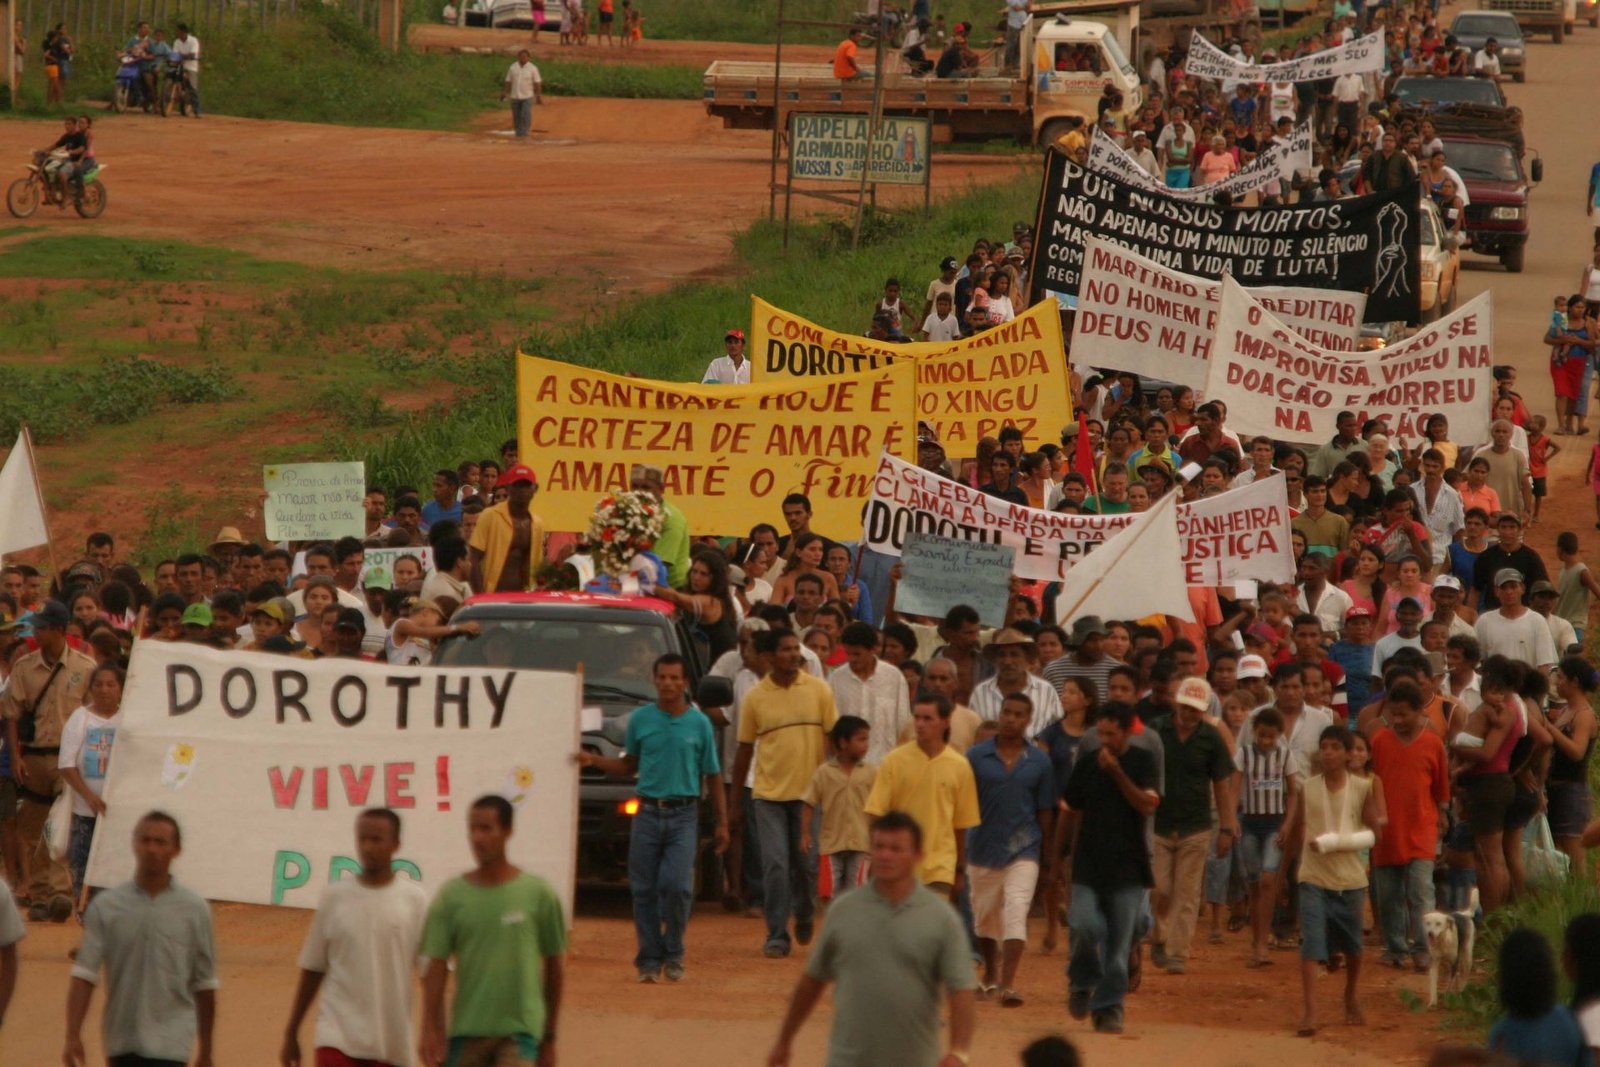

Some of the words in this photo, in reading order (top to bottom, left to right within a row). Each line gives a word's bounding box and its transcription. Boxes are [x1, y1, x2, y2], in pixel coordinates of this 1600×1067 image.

[795, 160, 831, 176] NOSSA
[1062, 160, 1116, 202] POR
[1129, 191, 1223, 230] NOSSOS
[1057, 193, 1096, 224] NÃO
[1100, 208, 1170, 246] APENAS
[1173, 228, 1202, 251] UM
[1205, 233, 1270, 257] MINUTO
[1274, 238, 1294, 257] DE
[1301, 231, 1368, 256] SILÊNCIO
[1046, 265, 1081, 286] REGI
[1092, 247, 1198, 298] MARTÍRIO
[1206, 287, 1220, 302] É
[1192, 253, 1234, 275] VIDA
[1242, 258, 1264, 276] DE
[1276, 254, 1340, 281] LUTA!
[1086, 278, 1120, 306] NO
[1127, 286, 1200, 327] HOMEM
[1247, 306, 1262, 326] O
[1448, 313, 1479, 340] SE
[767, 314, 825, 346] COM
[1080, 310, 1152, 343] DEUS
[1158, 326, 1186, 354] NA
[1457, 345, 1491, 369] NA
[537, 375, 559, 403] A
[569, 378, 742, 410] SANTIDADE
[759, 380, 859, 413] HOJE
[871, 374, 895, 413] É
[945, 383, 1039, 414] XINGU
[1226, 361, 1333, 409] DOAÇÃO
[1364, 378, 1476, 407] MORREU
[532, 415, 695, 453] CERTEZA
[709, 422, 756, 454] DE
[765, 424, 872, 458] AMAR
[883, 421, 904, 456] É
[976, 418, 1039, 442] PAZ
[1275, 406, 1313, 433] NA
[663, 455, 730, 497] ATÉ
[750, 468, 775, 498] O
[878, 457, 896, 476] A
[901, 466, 989, 511] GLEBA
[874, 476, 954, 523] CLAMA
[961, 509, 976, 525] A
[983, 510, 1065, 541] PERDA
[1077, 530, 1106, 541] DA
[1024, 537, 1044, 556] E
[166, 663, 518, 730] DOROTHY
